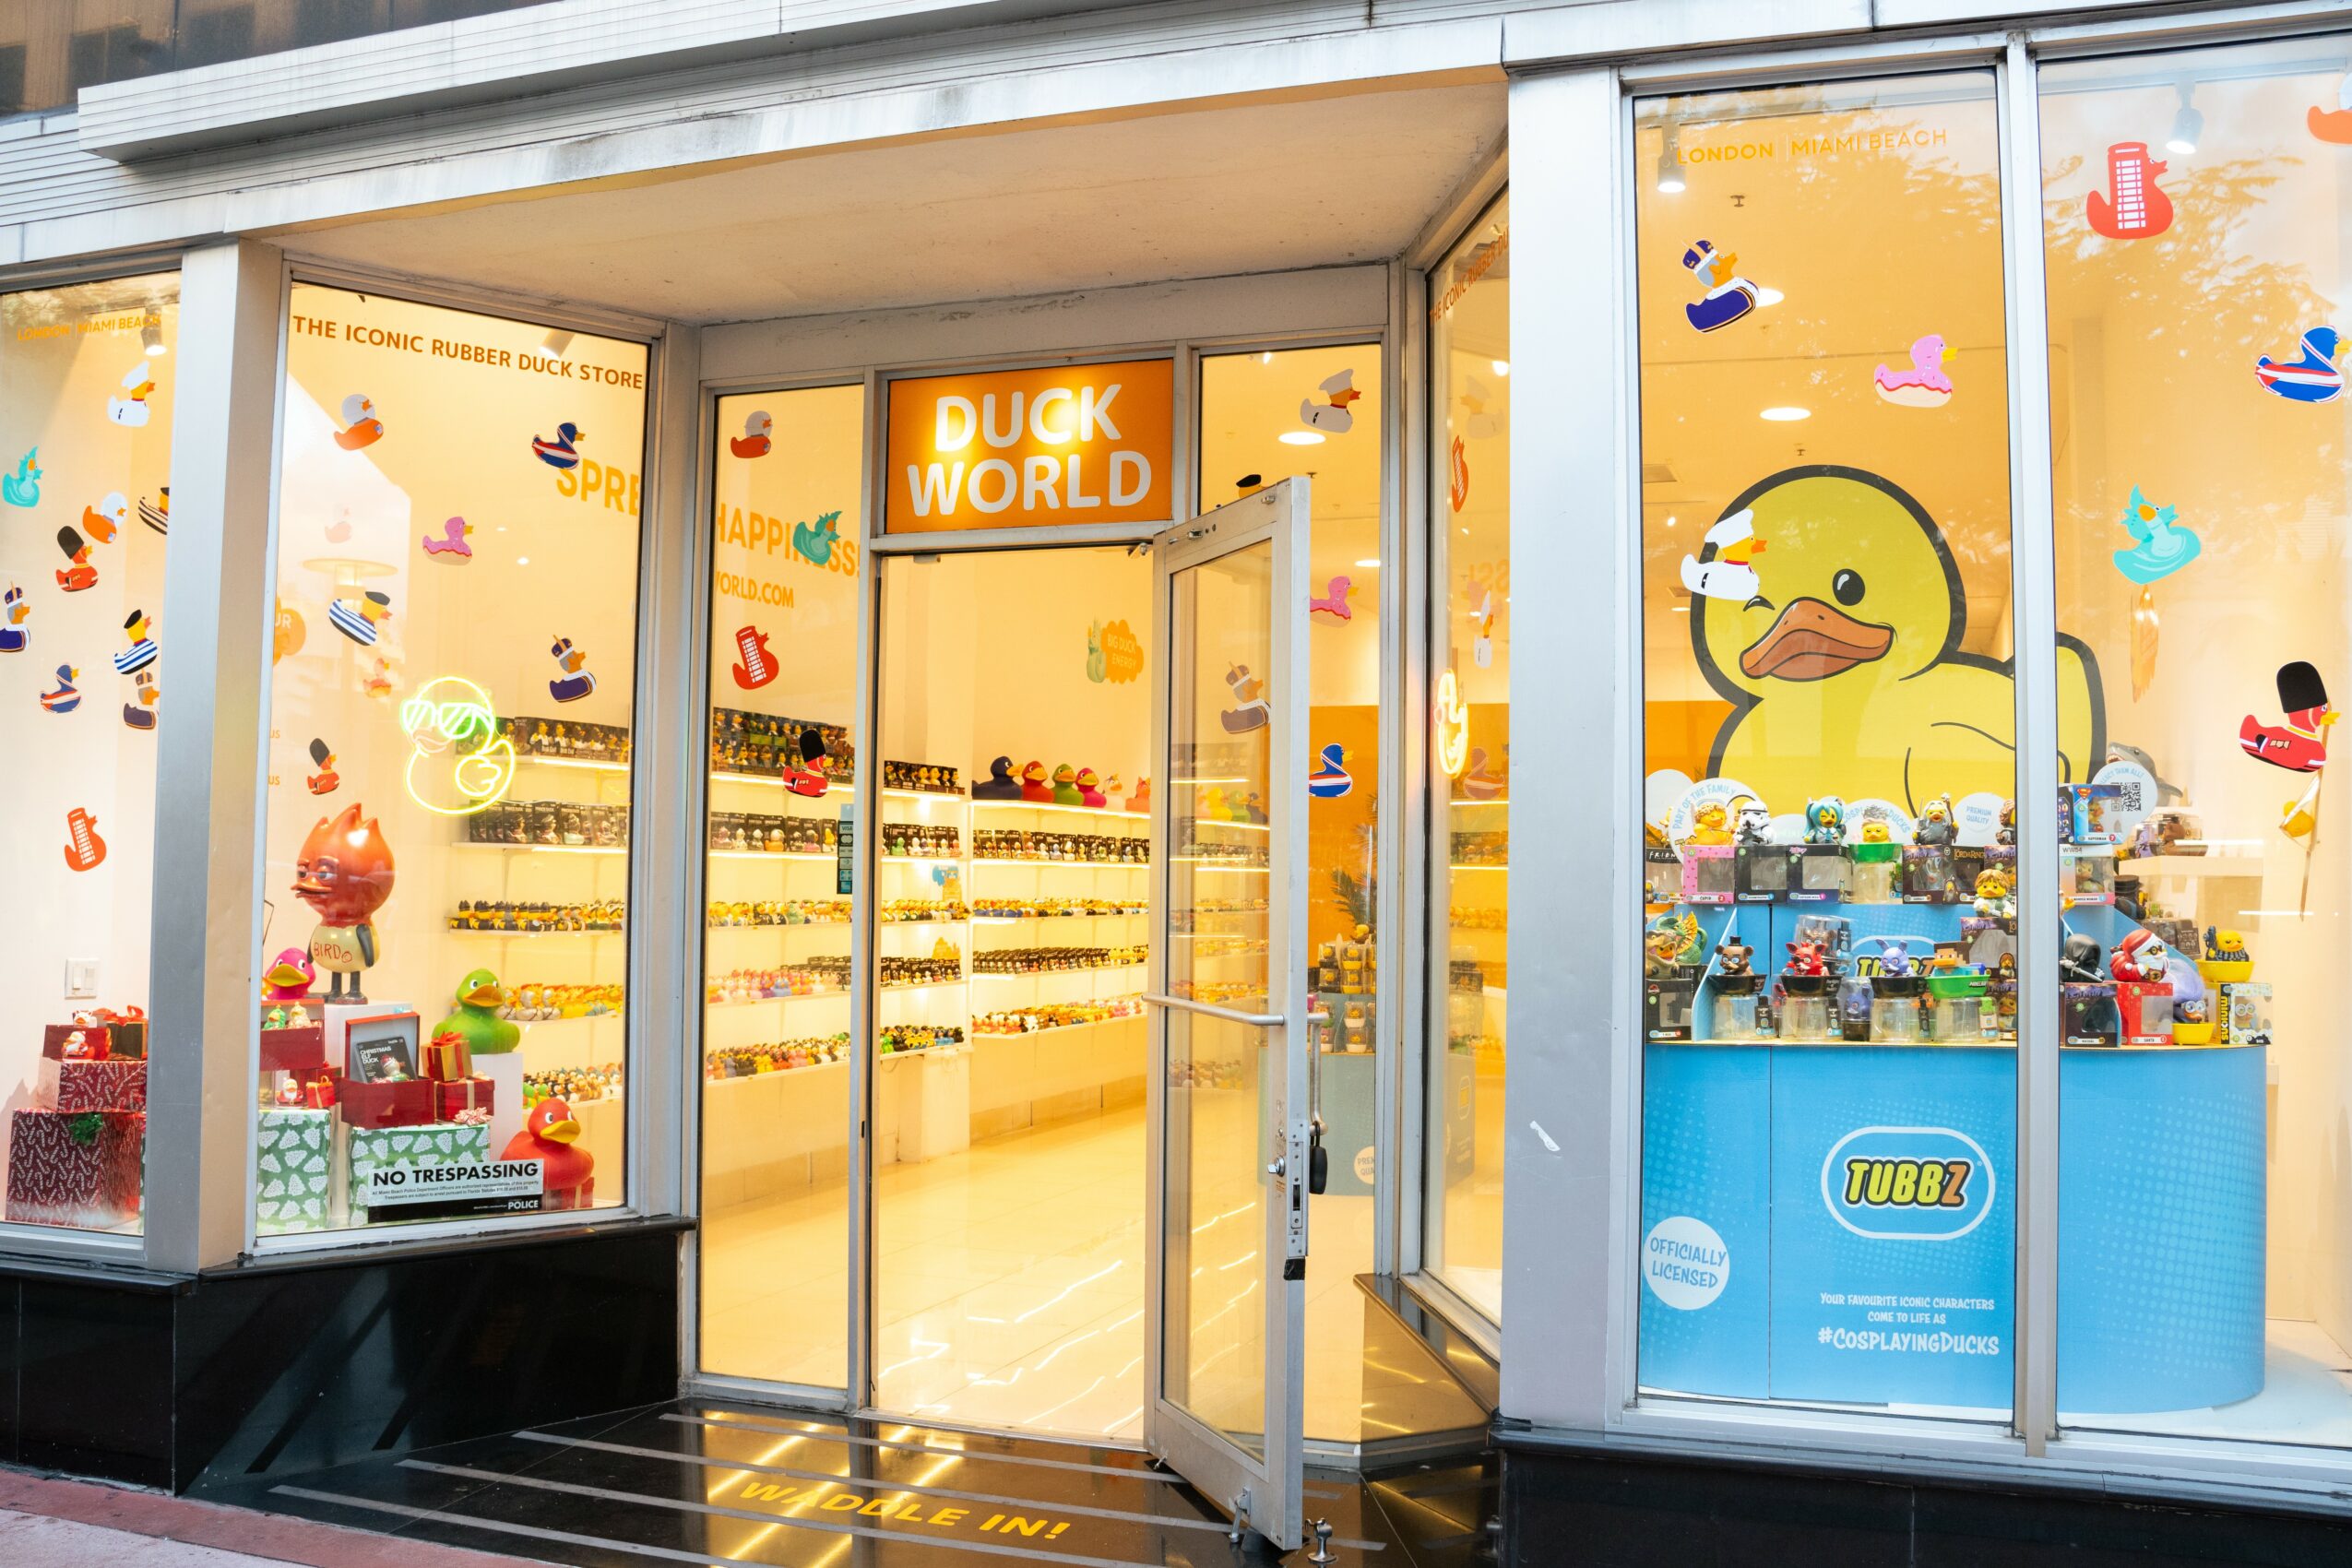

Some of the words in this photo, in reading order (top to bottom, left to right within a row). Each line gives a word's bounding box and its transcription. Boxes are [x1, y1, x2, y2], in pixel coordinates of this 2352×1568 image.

[1678, 142, 1773, 165] LONDON
[1791, 133, 1860, 156] MIAMI
[1869, 129, 1946, 149] BEACH
[1443, 273, 1467, 314] ICONIC
[1467, 241, 1496, 287] RUBBER
[17, 324, 70, 341] LONDON
[77, 320, 115, 334] MIAMI
[119, 314, 161, 329] BEACH
[292, 315, 336, 339] THE
[346, 324, 423, 353] ICONIC
[432, 339, 511, 368] RUBBER
[518, 354, 573, 377] DUCK
[580, 364, 643, 389] STORE
[935, 384, 1123, 453] DUCK
[907, 450, 1152, 517] WORLD
[718, 503, 860, 577] HAPPISS!
[1107, 633, 1119, 649] BIG
[1119, 636, 1136, 654] DUCK
[1112, 653, 1136, 670] ENERGY
[1672, 808, 1686, 829] PART
[1682, 797, 1692, 809] OF
[1691, 787, 1705, 800] THE
[1706, 783, 1737, 796] FAMILY
[1966, 805, 1992, 815] PREMIUM
[1966, 814, 1990, 824] QUALITY
[2220, 996, 2229, 1040] MINIONS
[360, 1046, 392, 1055] CHRISTMAS
[374, 1170, 406, 1187] NO
[412, 1162, 539, 1183] TRESPASSING
[1845, 1158, 1971, 1207] TUBBZ
[508, 1200, 539, 1210] POLICE
[1650, 1237, 1727, 1267] OFFICIALLY
[1652, 1259, 1718, 1289] LICENSED
[1820, 1292, 1845, 1305] YOUR
[1847, 1294, 1897, 1307] FAVOURITE
[1899, 1296, 1930, 1308] ICONIC
[1932, 1298, 1995, 1311] CHARACTERS
[1868, 1311, 1894, 1323] COME
[1896, 1313, 1907, 1323] TO
[1910, 1313, 1930, 1324] LIFE
[1933, 1313, 1946, 1324] AS
[740, 1481, 970, 1526] WADDLE
[978, 1514, 1070, 1540] IN!
